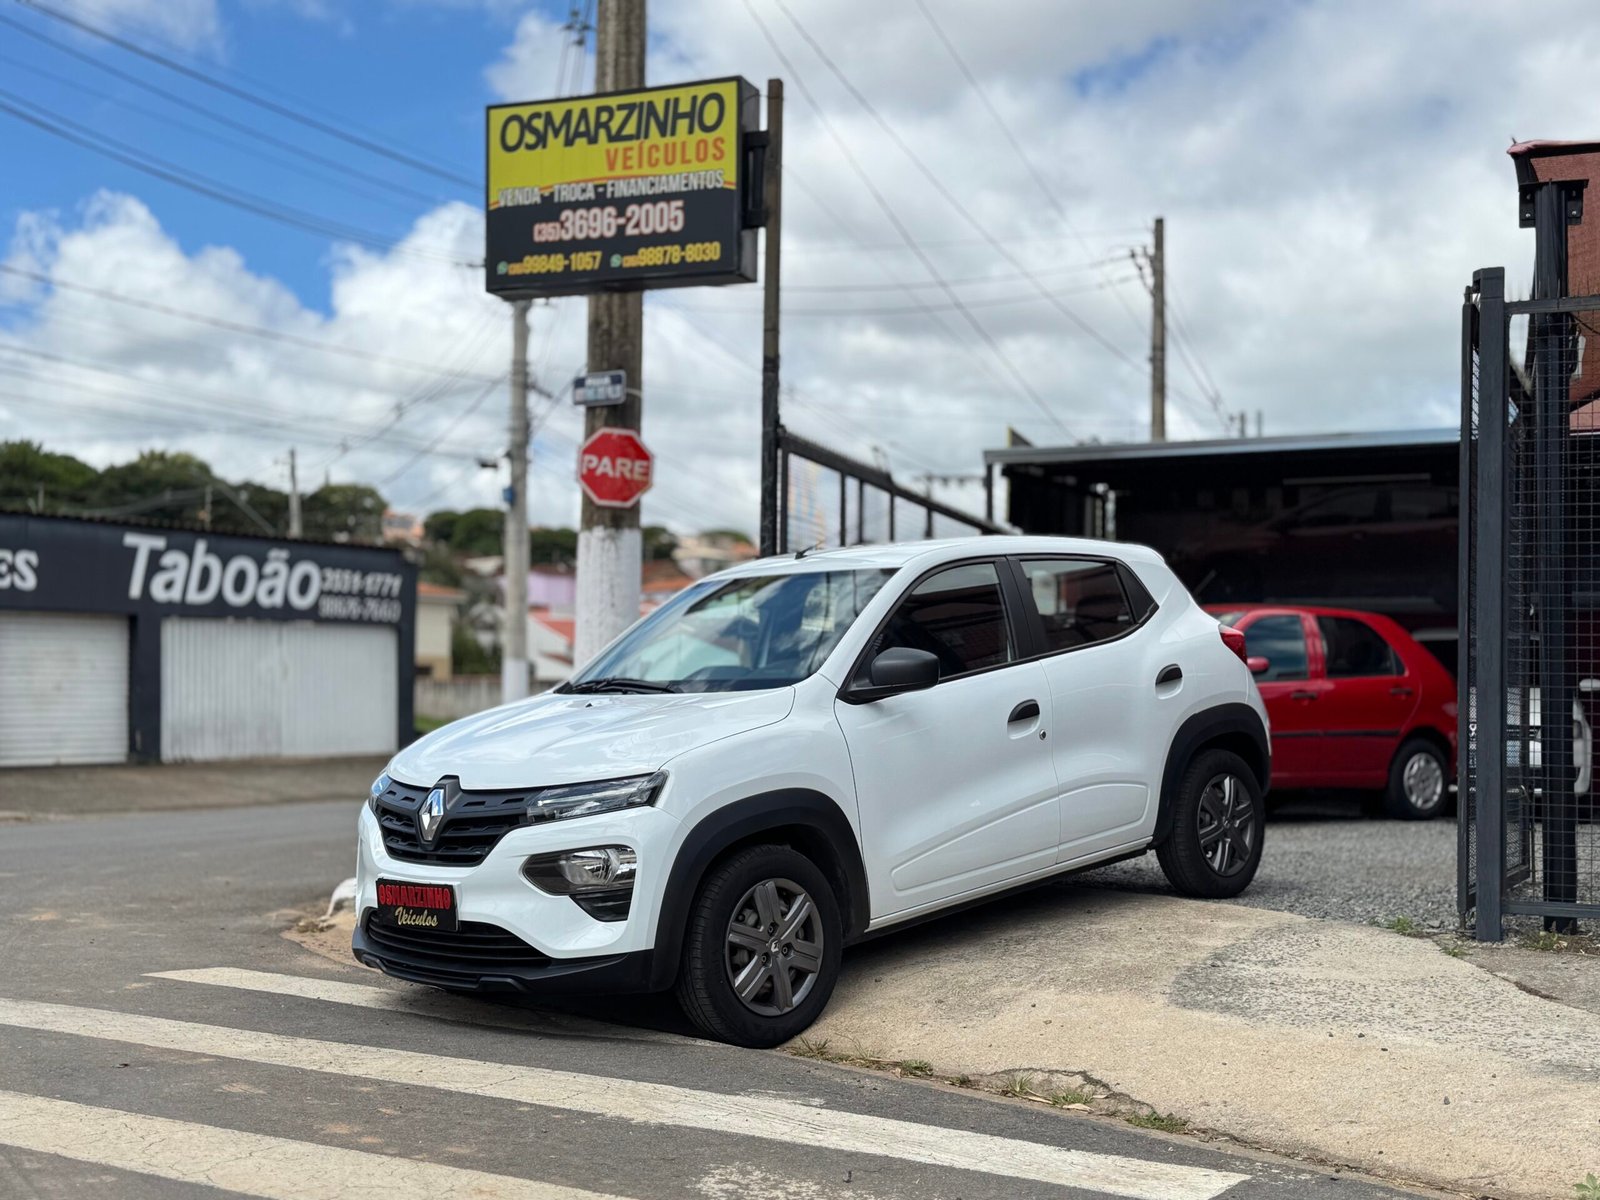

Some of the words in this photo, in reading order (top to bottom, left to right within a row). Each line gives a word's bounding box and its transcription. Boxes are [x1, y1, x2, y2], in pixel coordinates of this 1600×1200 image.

[500, 92, 726, 153] OSMARZINHO
[605, 137, 726, 171] VEÍCULOS
[498, 186, 541, 207] VENDA
[552, 182, 595, 203] TROCA
[606, 170, 724, 199] FINANCIAMENTOS
[582, 453, 649, 481] PARE
[123, 532, 321, 610] Taboão
[378, 884, 451, 910] OSMARZINHO
